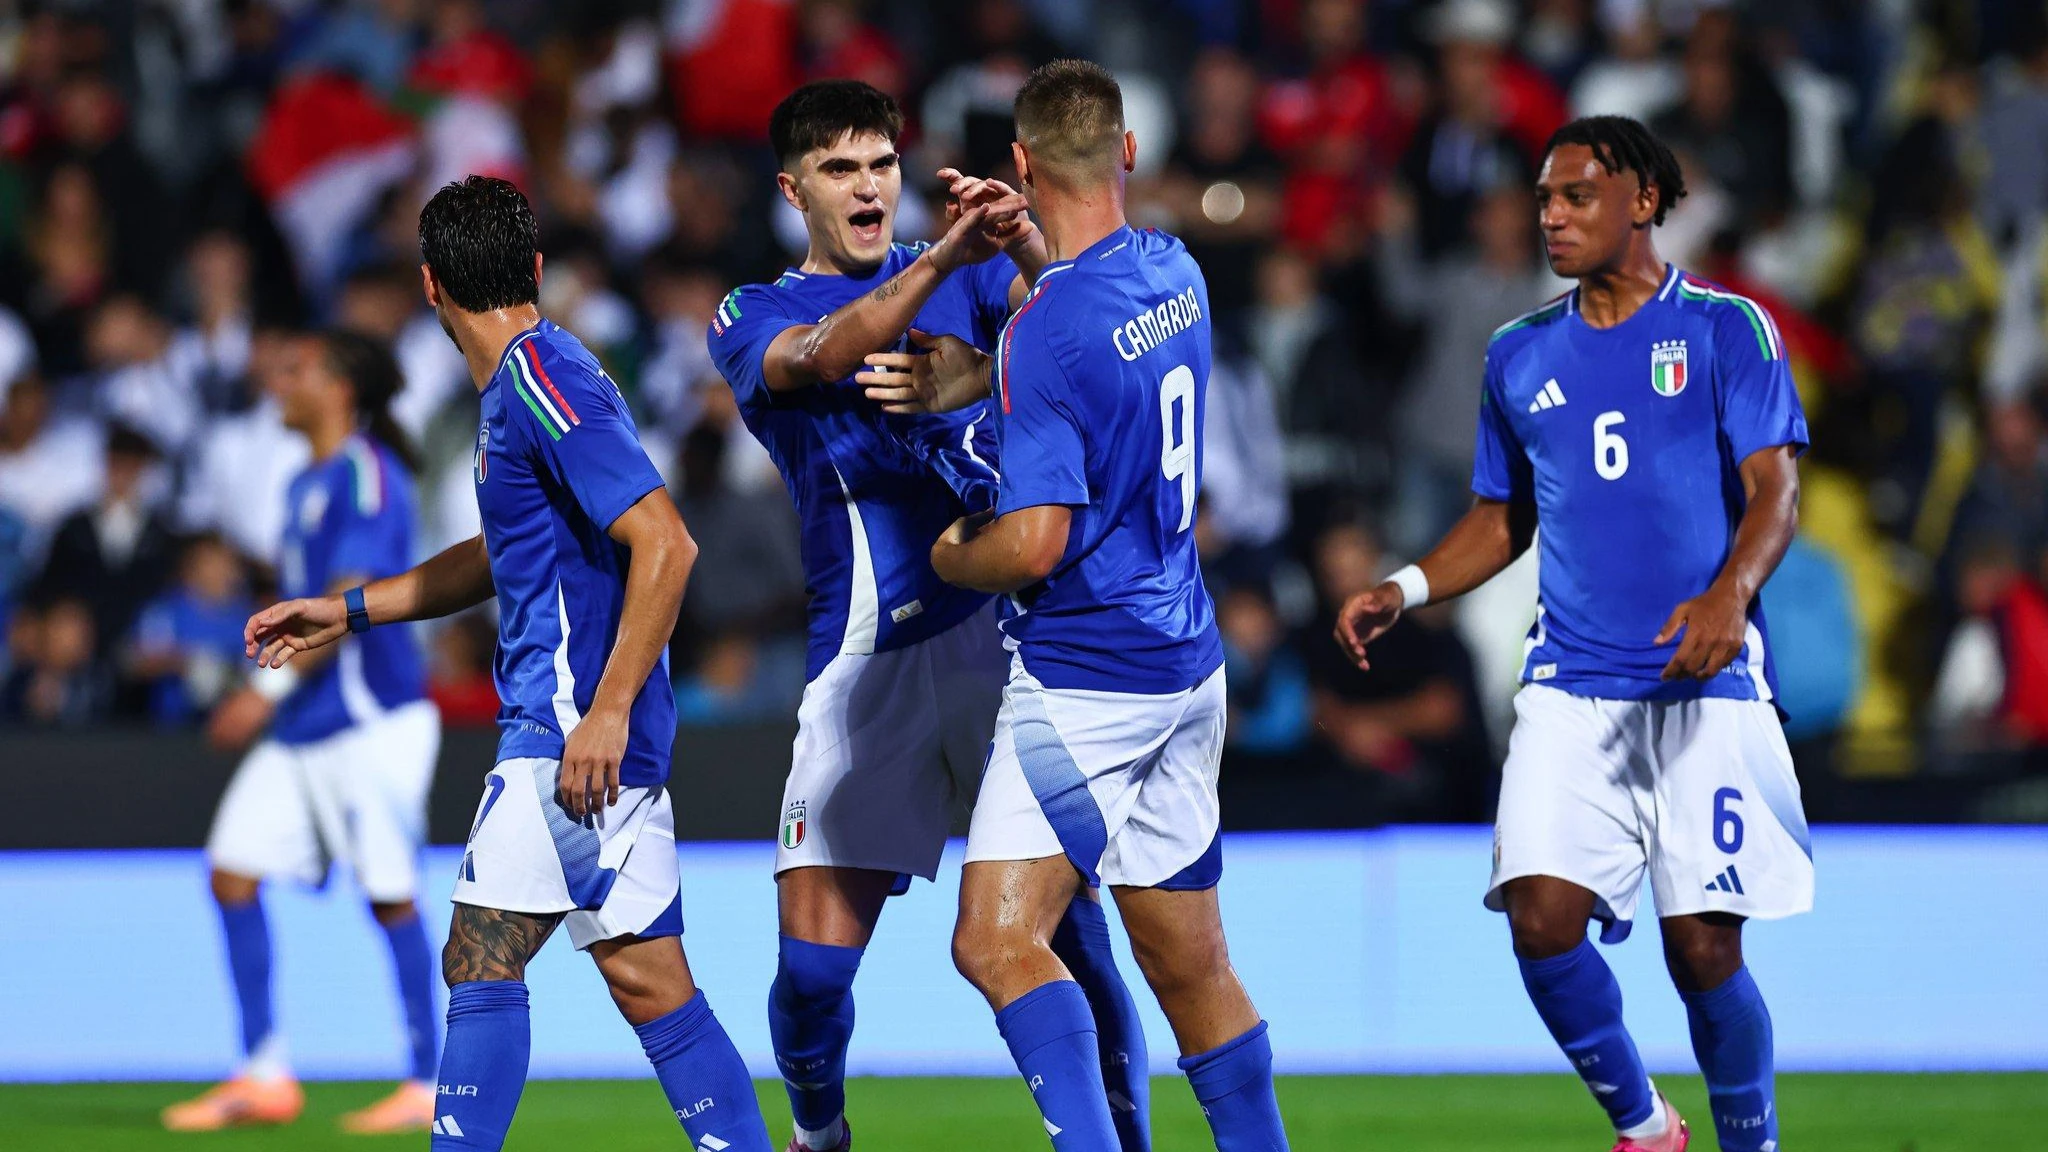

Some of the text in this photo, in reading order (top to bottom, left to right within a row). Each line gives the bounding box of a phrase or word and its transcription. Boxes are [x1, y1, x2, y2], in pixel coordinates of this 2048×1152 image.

[1112, 285, 1202, 361] CAMARDA
[1159, 364, 1196, 534] 9
[1593, 409, 1630, 480] 6
[520, 723, 550, 737] AT.RDY
[1713, 786, 1744, 855] 6
[437, 1084, 478, 1097] ALIA
[675, 1097, 715, 1120] ALIA
